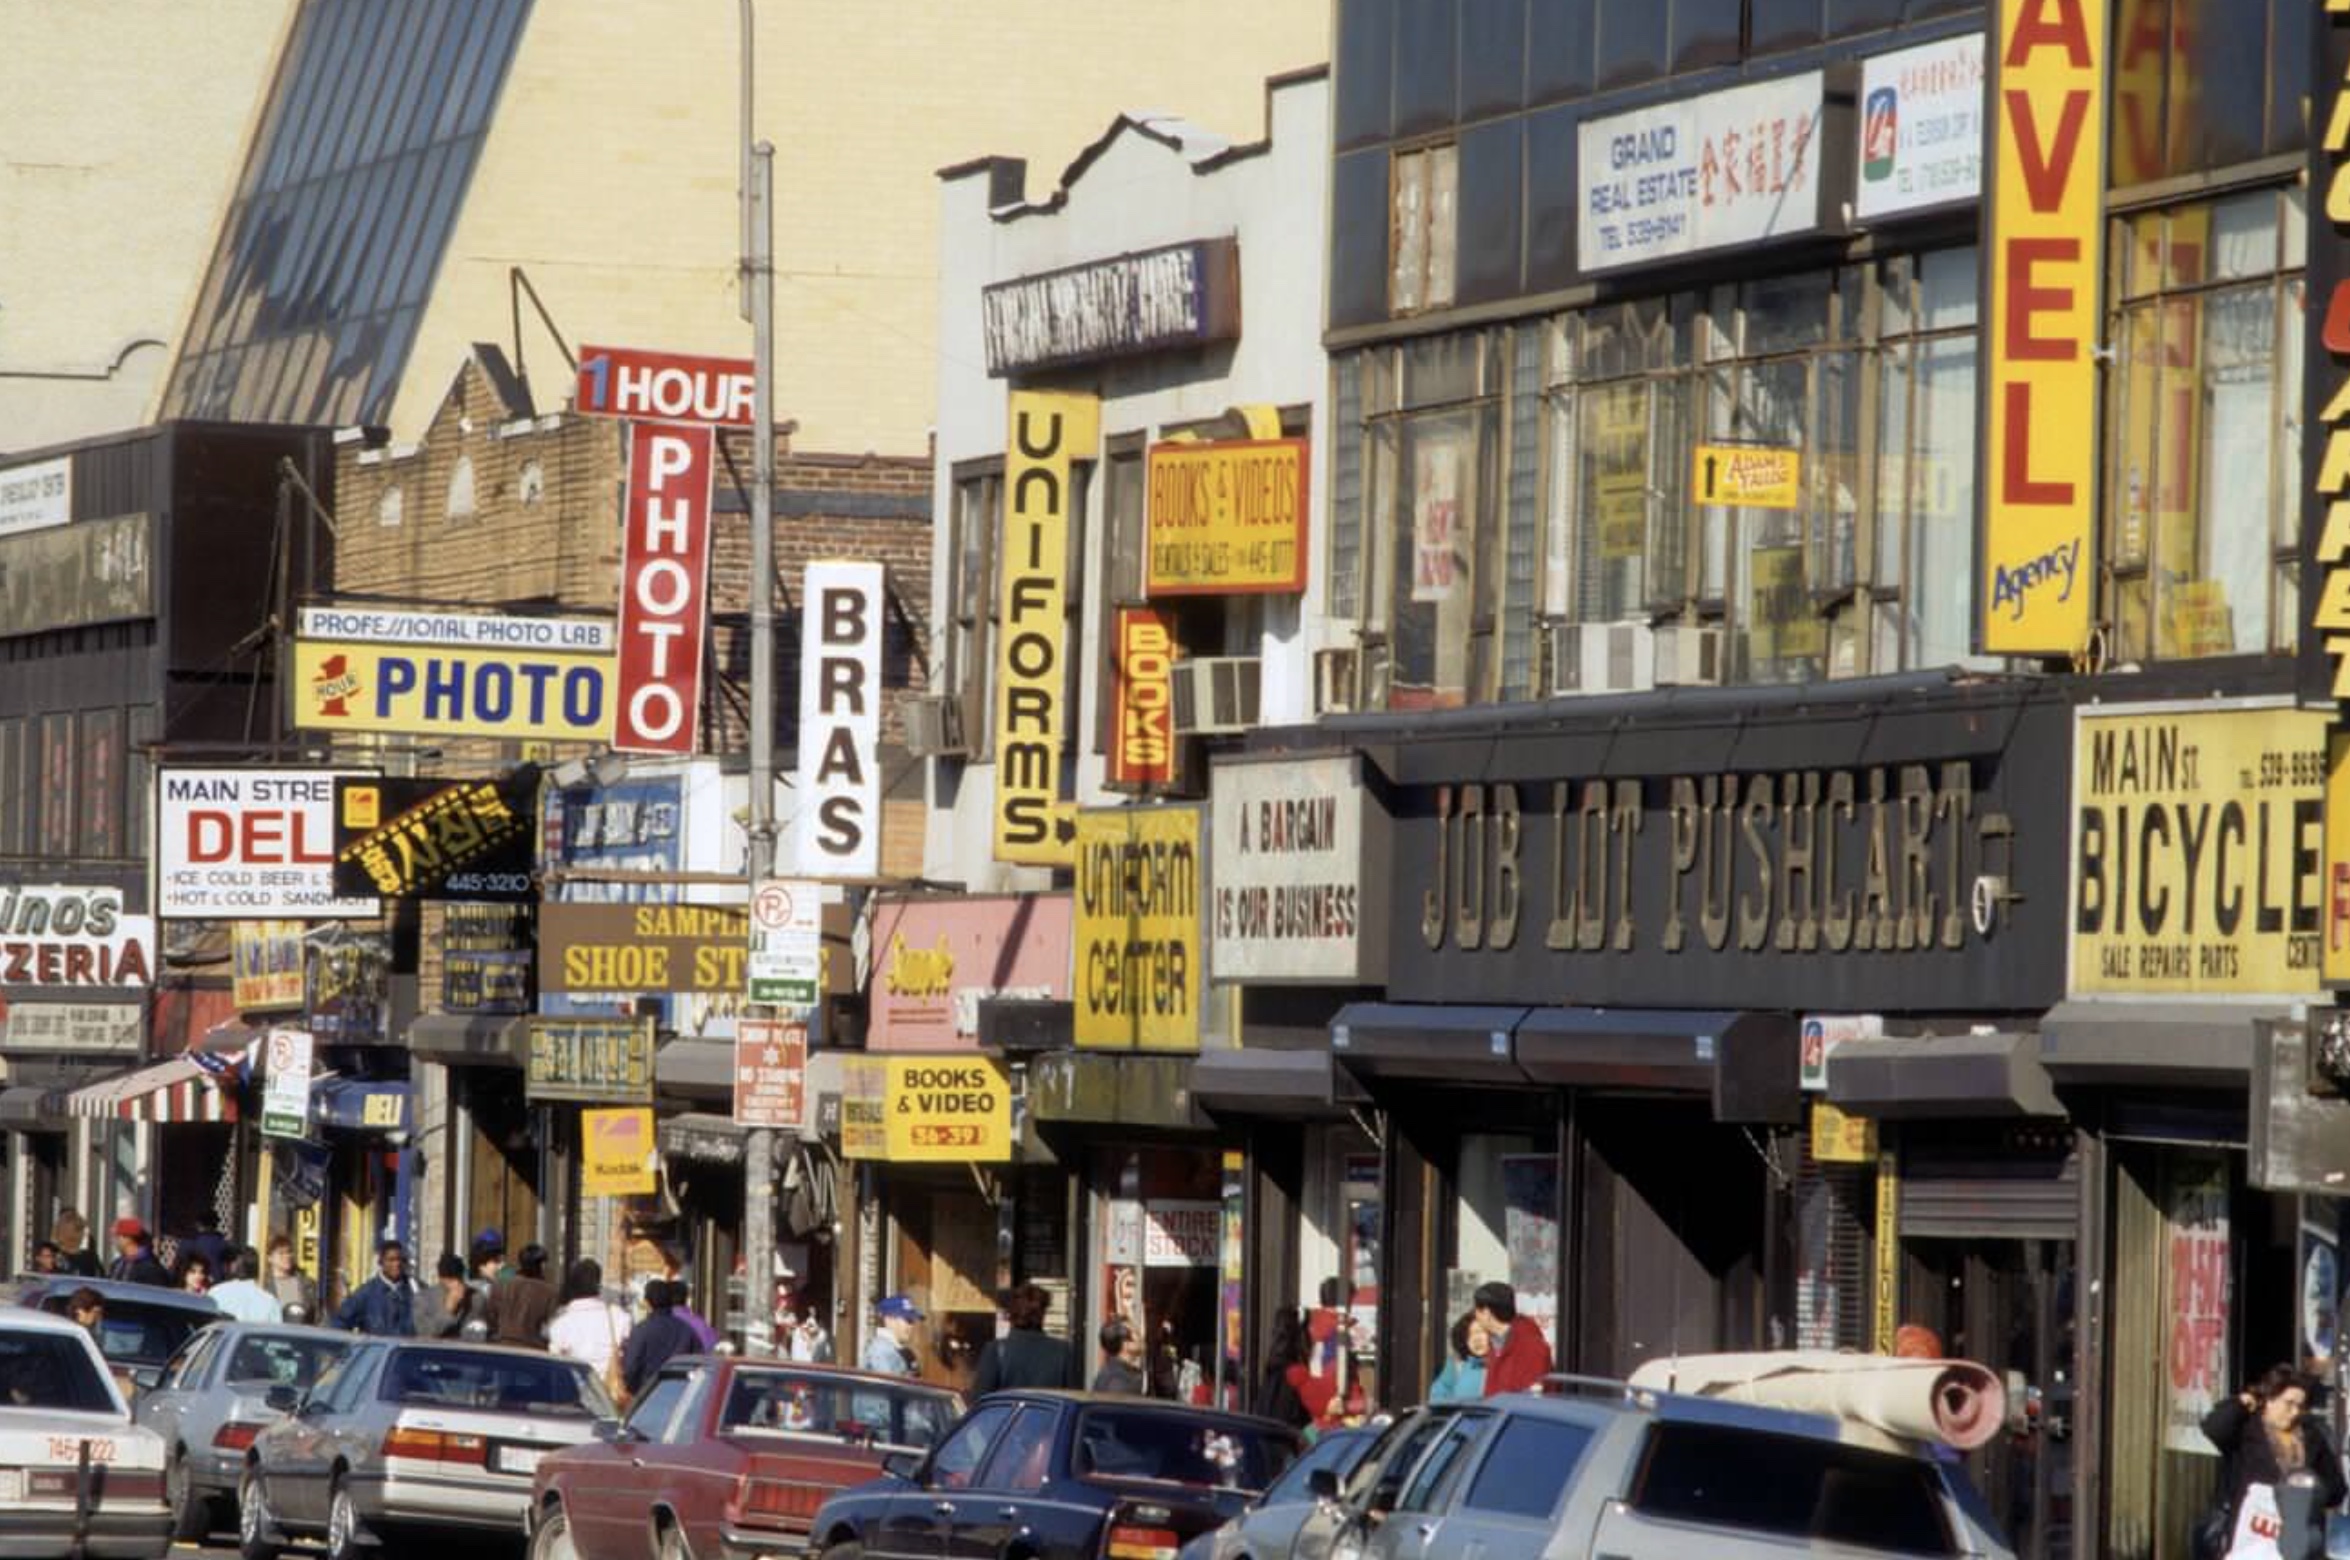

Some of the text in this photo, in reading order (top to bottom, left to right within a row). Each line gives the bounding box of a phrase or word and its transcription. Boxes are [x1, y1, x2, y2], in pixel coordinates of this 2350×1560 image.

[1611, 126, 1676, 170] GRAND
[1591, 166, 1697, 216] REAL ESTATE
[581, 354, 755, 420] 1 HOUR
[1154, 461, 1211, 527] BOOKS
[1232, 457, 1296, 527] VIDEOS
[629, 436, 692, 741] PHOTO
[1991, 539, 2080, 621] Agency
[313, 613, 601, 645] PROFESSIONAL PHOTO LAB
[376, 656, 604, 727] PHOTO
[1126, 623, 1172, 766] BOOKS
[816, 587, 867, 855] BRAS
[2092, 726, 2178, 796] MAIN
[168, 779, 330, 802] MAIN STRE
[188, 809, 334, 864] DEL
[1239, 796, 1337, 854] A BARGAIN
[208, 871, 253, 886] COLD
[260, 871, 304, 886] BEER
[446, 873, 530, 892] 445-3210
[1083, 840, 1195, 919] UNIFORM
[1423, 760, 1973, 952] JOB LOT PUSHCART
[2077, 798, 2322, 937] BICYCLE
[174, 890, 206, 906] HOT
[227, 890, 271, 907] COLD
[1216, 883, 1357, 941] IS OUR BUSINESS
[565, 945, 669, 988] SHOE
[1086, 939, 1188, 1017] CENTER
[2102, 945, 2131, 978] SALE
[2139, 943, 2192, 978] REPAIRS
[2199, 942, 2240, 977] PARTS
[897, 1092, 996, 1114] & VIDEO
[904, 1068, 987, 1090] BOOKS
